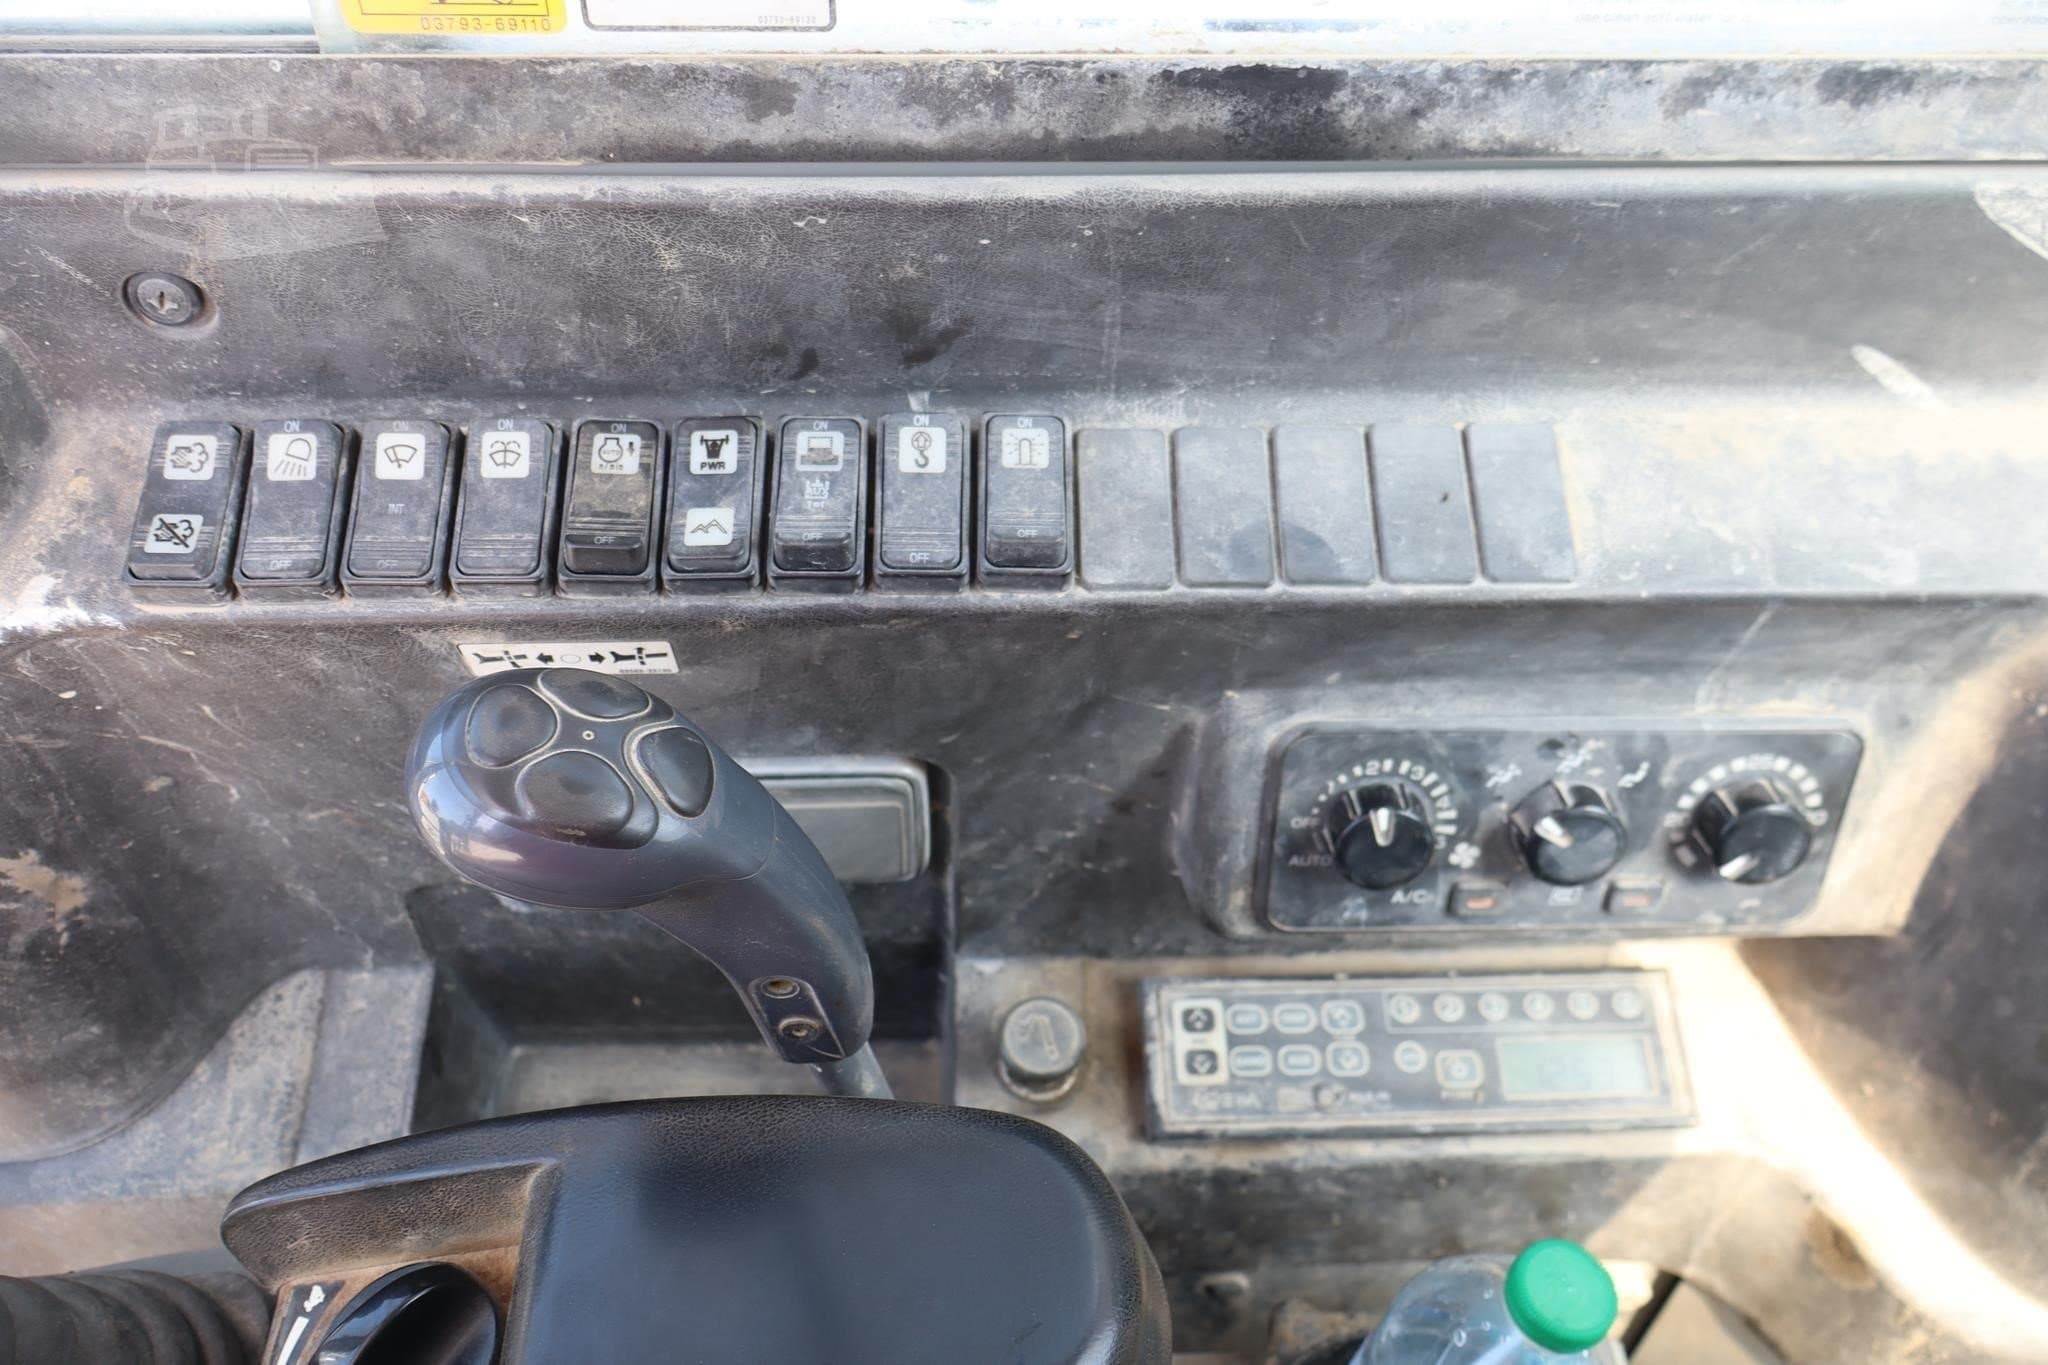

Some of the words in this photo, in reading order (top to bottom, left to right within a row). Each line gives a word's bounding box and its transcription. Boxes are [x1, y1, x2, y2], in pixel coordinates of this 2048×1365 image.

[420, 17, 552, 32] 03793-69110
[497, 418, 514, 431] ON
[812, 420, 829, 431] ON
[913, 414, 930, 426] ON
[1016, 417, 1033, 429] ON
[284, 420, 300, 433] ON
[610, 423, 627, 433] ON
[700, 461, 726, 471] PWR
[1016, 529, 1039, 538] OFF
[593, 536, 617, 545] OFF
[909, 552, 931, 564] OFF
[269, 559, 292, 570] OFF
[1365, 760, 1380, 776] 2
[1410, 765, 1425, 780] 3
[1288, 854, 1334, 867] AUTO
[1390, 888, 1429, 905] A/C
